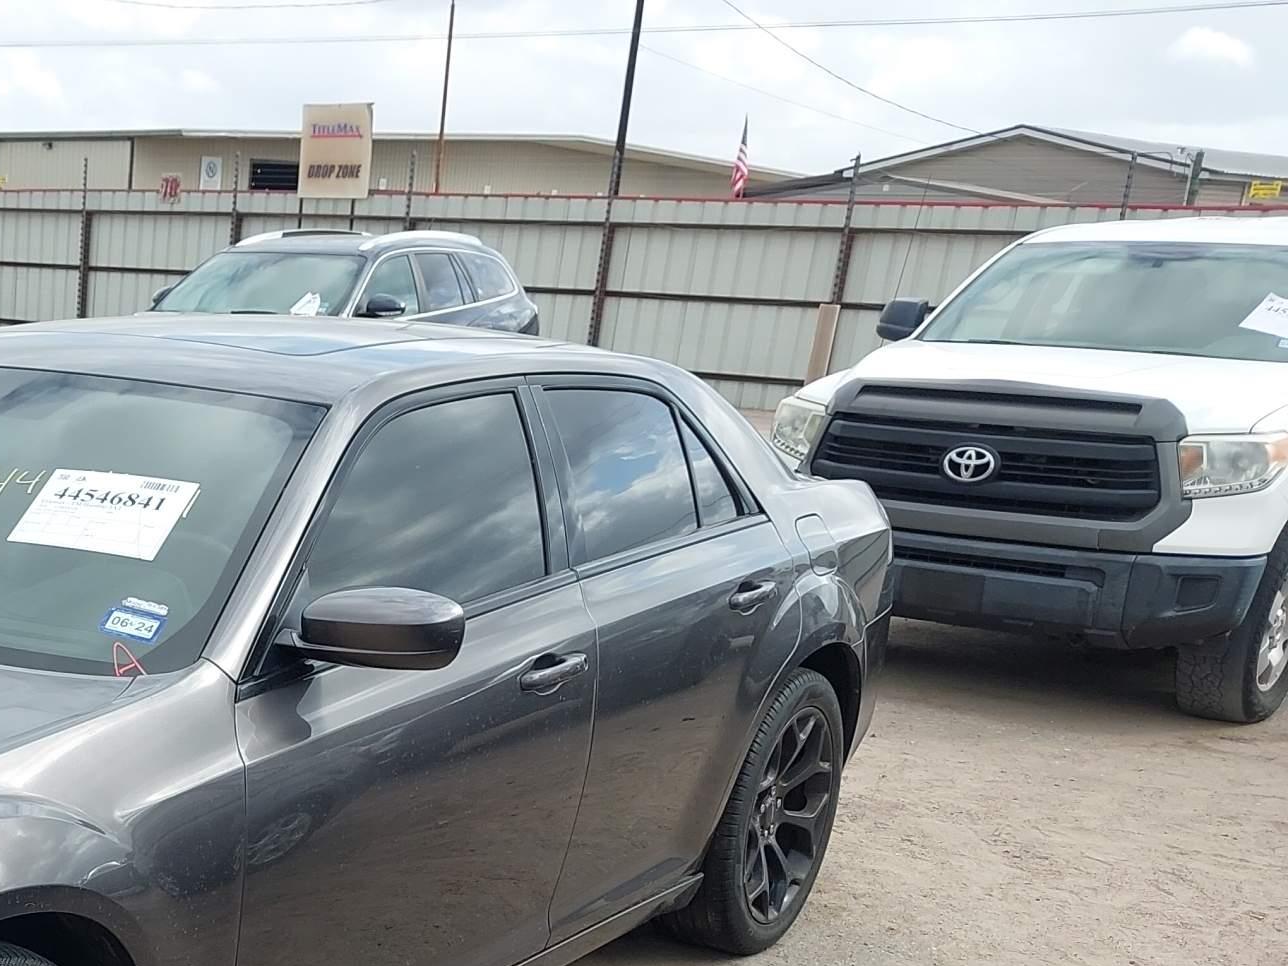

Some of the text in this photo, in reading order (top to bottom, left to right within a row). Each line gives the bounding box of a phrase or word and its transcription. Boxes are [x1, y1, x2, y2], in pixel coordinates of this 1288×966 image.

[307, 164, 362, 179] DROP ZONE
[53, 486, 167, 511] 44546841
[111, 616, 155, 634] 06 24
